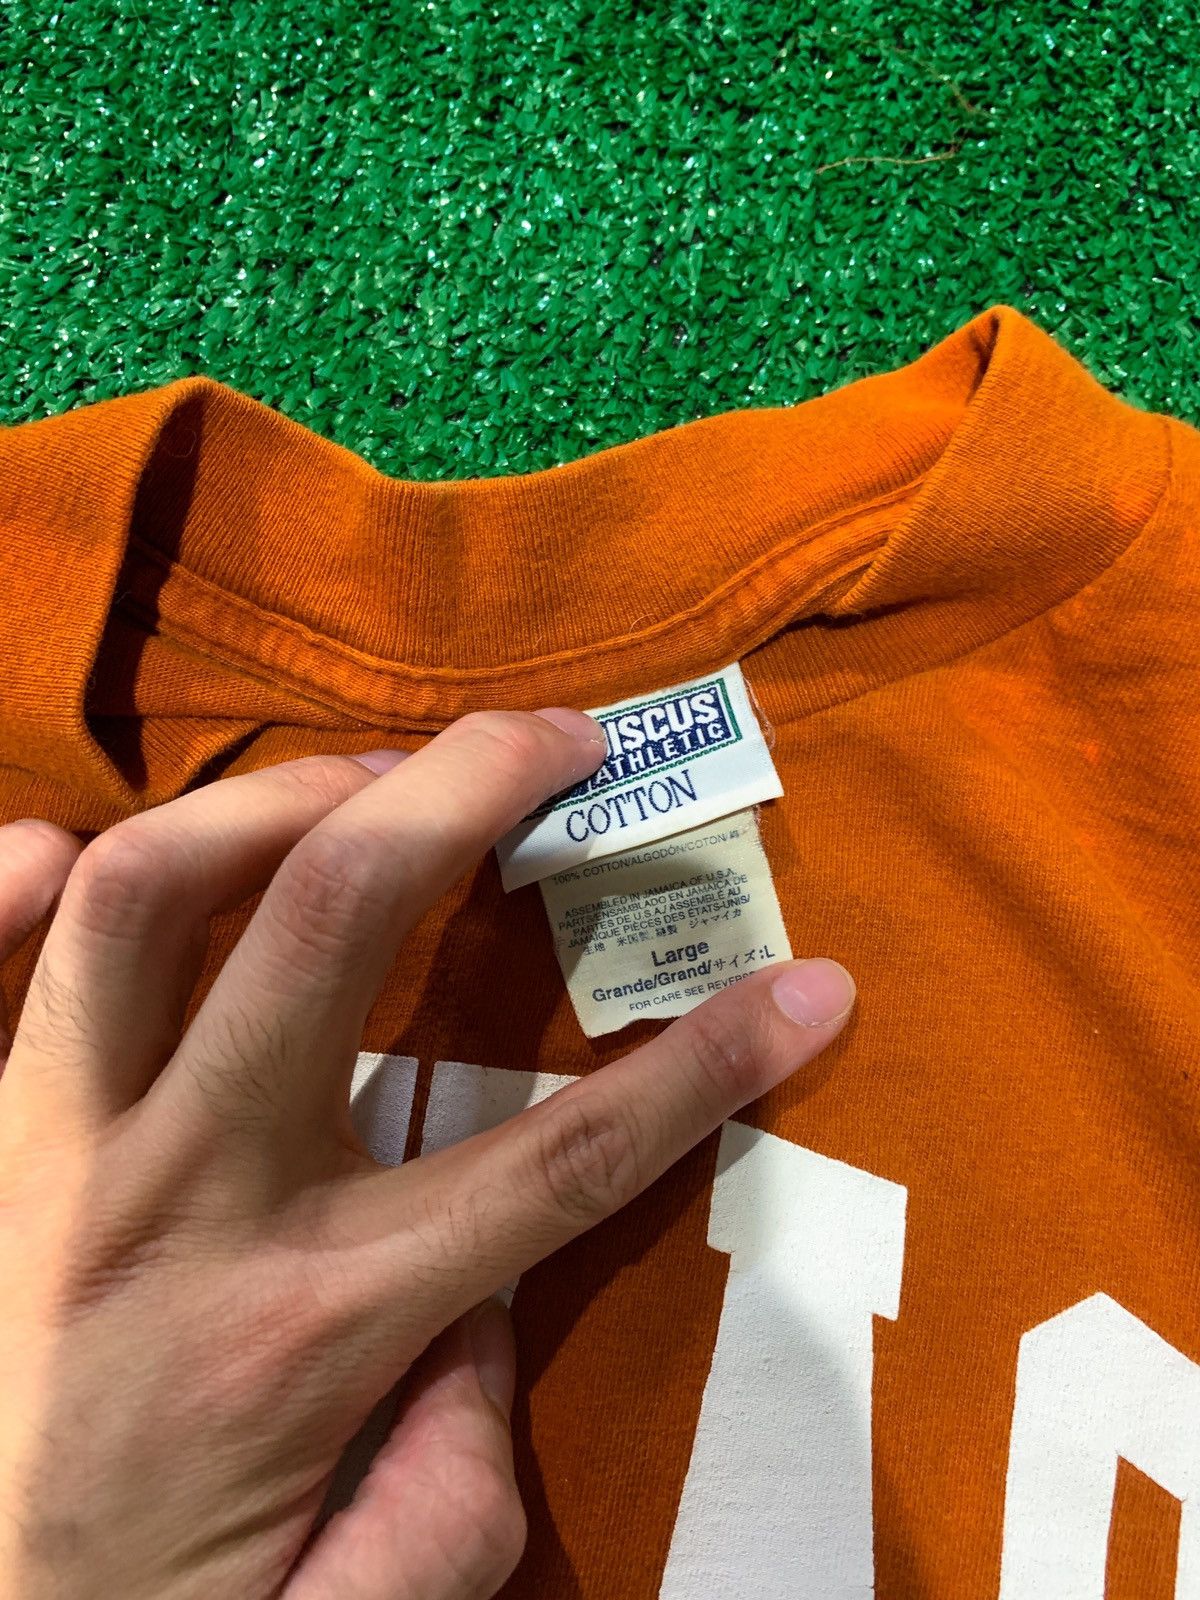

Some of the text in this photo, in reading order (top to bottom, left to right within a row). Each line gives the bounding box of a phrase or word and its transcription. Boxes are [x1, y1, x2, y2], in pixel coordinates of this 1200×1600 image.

[606, 692, 719, 758] ISCUS
[597, 722, 724, 784] ATHLETIC
[566, 769, 698, 843] COTTON
[553, 872, 580, 885] 100%
[565, 868, 737, 918] ASSEMBLED IN JAMAICA OF U.S.A.
[668, 891, 684, 902] EN
[686, 879, 731, 898] JAMAICA
[733, 874, 748, 885] DE
[573, 919, 614, 938] PARTES
[616, 914, 631, 925] DE
[728, 886, 741, 896] AU
[622, 917, 661, 933] PIÈCES
[663, 911, 685, 924] DES
[689, 909, 741, 928] ジャマイカ
[651, 941, 710, 967] Large
[629, 971, 755, 1011] FOR CARE SEE REVER
